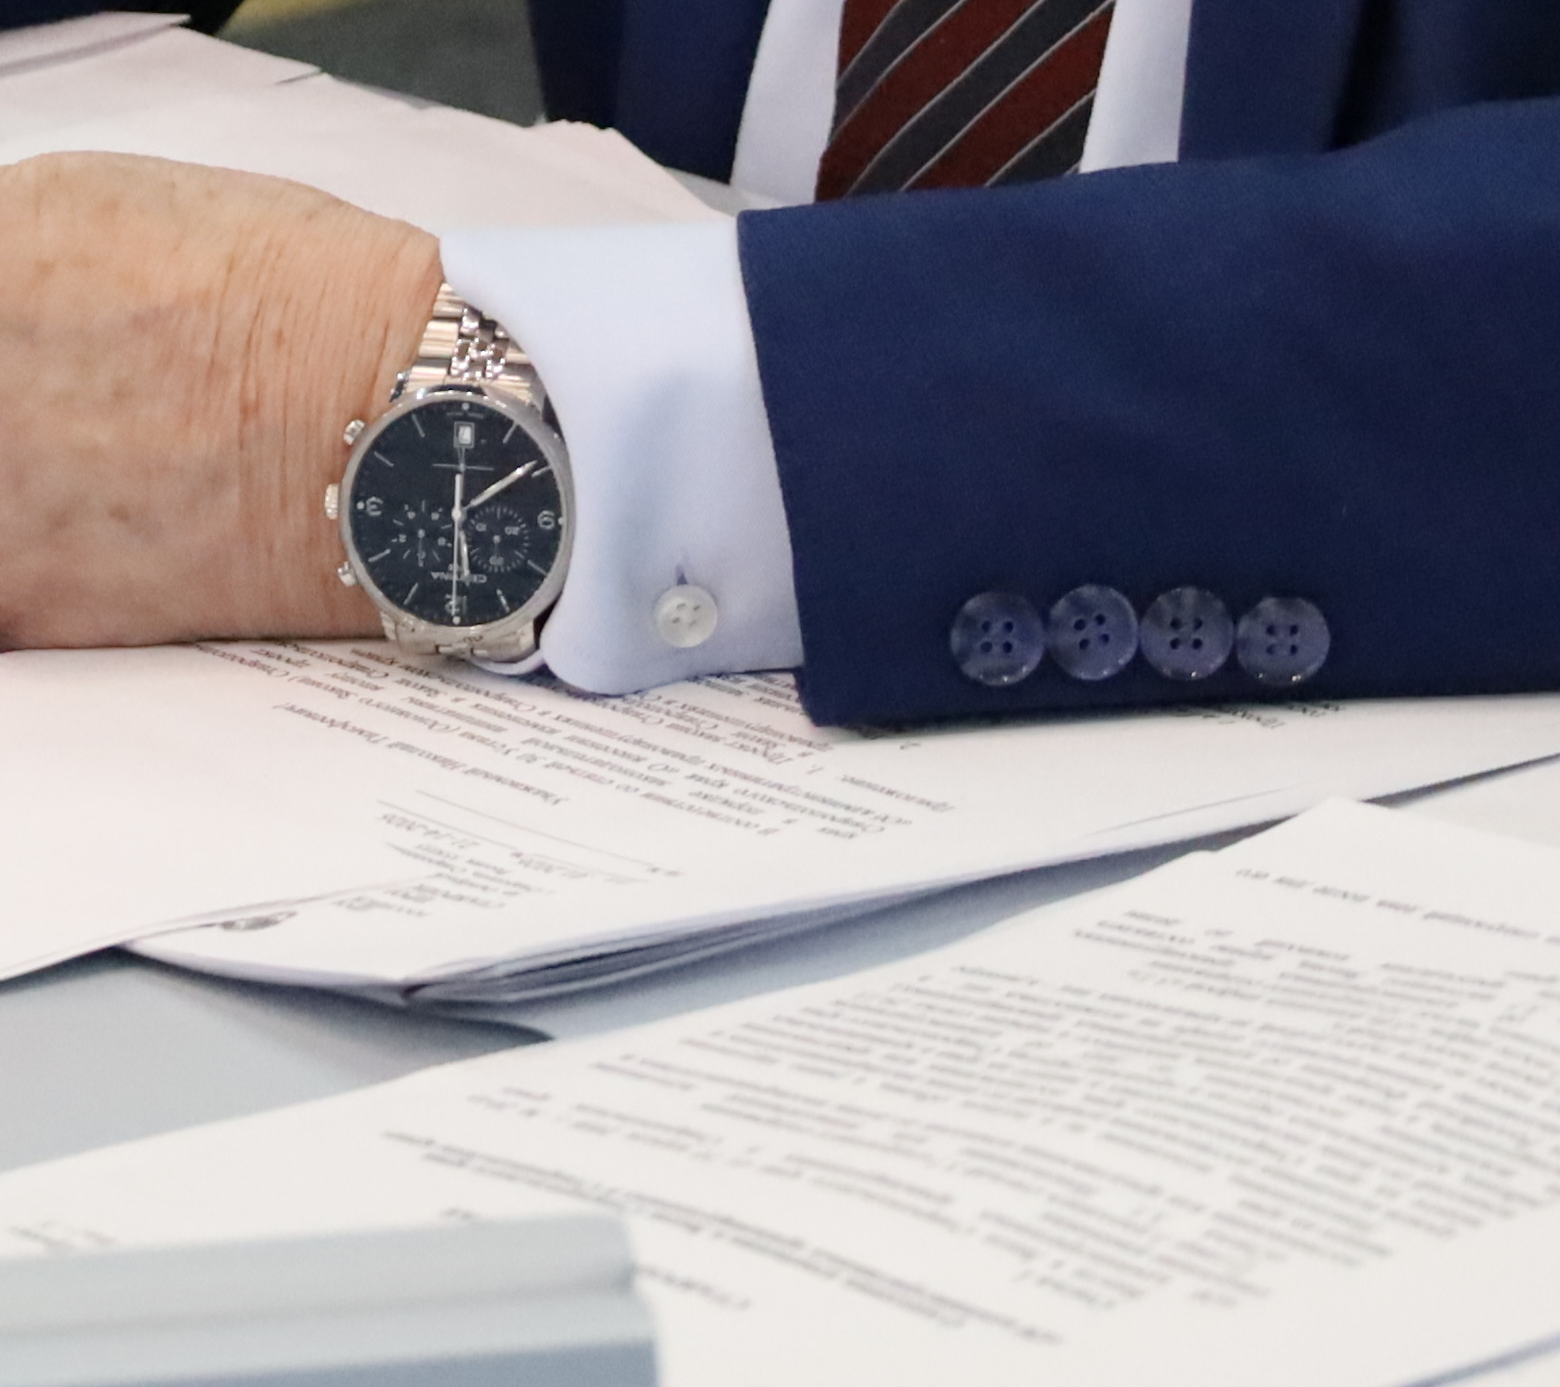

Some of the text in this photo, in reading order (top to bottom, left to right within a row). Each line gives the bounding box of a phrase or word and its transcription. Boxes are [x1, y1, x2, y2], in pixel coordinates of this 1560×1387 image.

[365, 496, 383, 516] 3
[536, 509, 555, 529] 9
[288, 676, 358, 699] Закона)
[358, 698, 461, 732] (Основного
[401, 696, 508, 733] инициативы
[273, 703, 568, 805] Уважаемый Николай Тимофеевич!
[458, 731, 519, 756] Устава
[552, 714, 706, 765] правонарушениях
[724, 742, 793, 765] Проект
[520, 737, 672, 787] законодательной
[542, 761, 615, 784] статьей
[615, 784, 640, 793] со
[688, 791, 764, 815] порядке
[706, 763, 875, 816] административных
[639, 792, 760, 829] соответствии
[733, 788, 885, 833] Ставропольского
